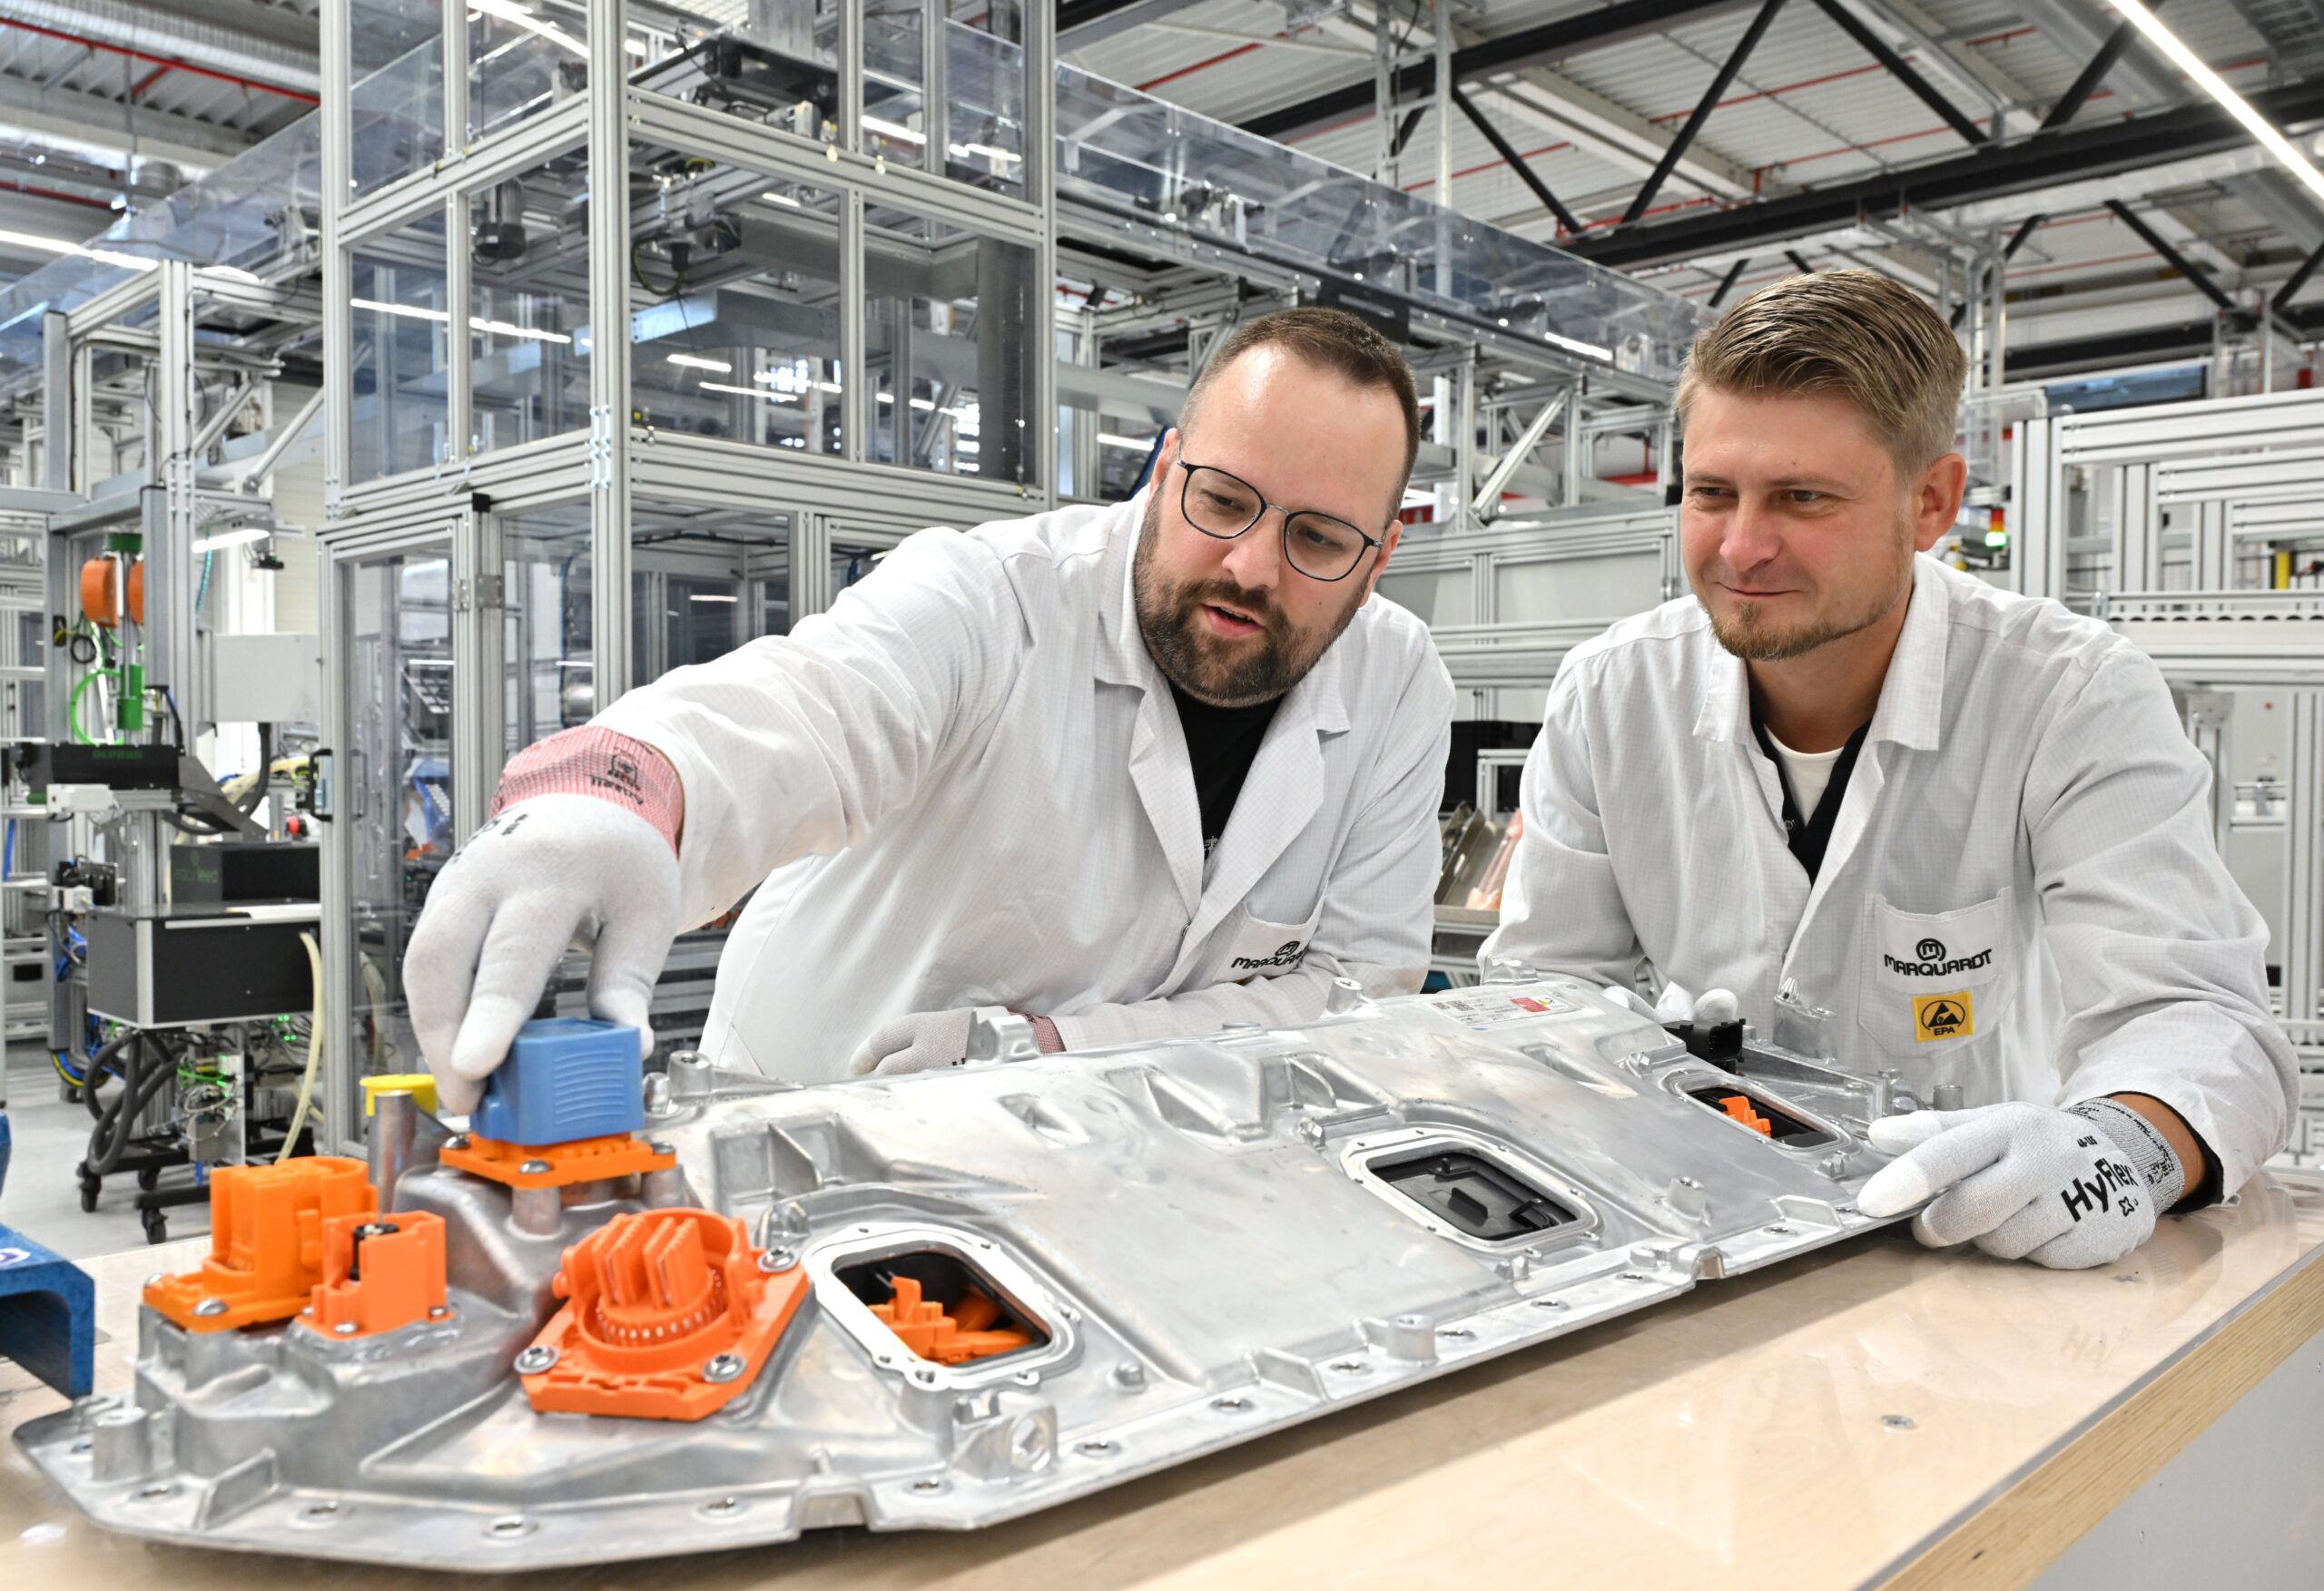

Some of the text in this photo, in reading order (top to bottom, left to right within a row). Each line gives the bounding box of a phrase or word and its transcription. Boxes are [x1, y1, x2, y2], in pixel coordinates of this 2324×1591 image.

[1884, 948, 1992, 977] MARQUARDT
[1934, 1026, 1955, 1036] EPA
[2061, 1158, 2139, 1223] HyFlex
